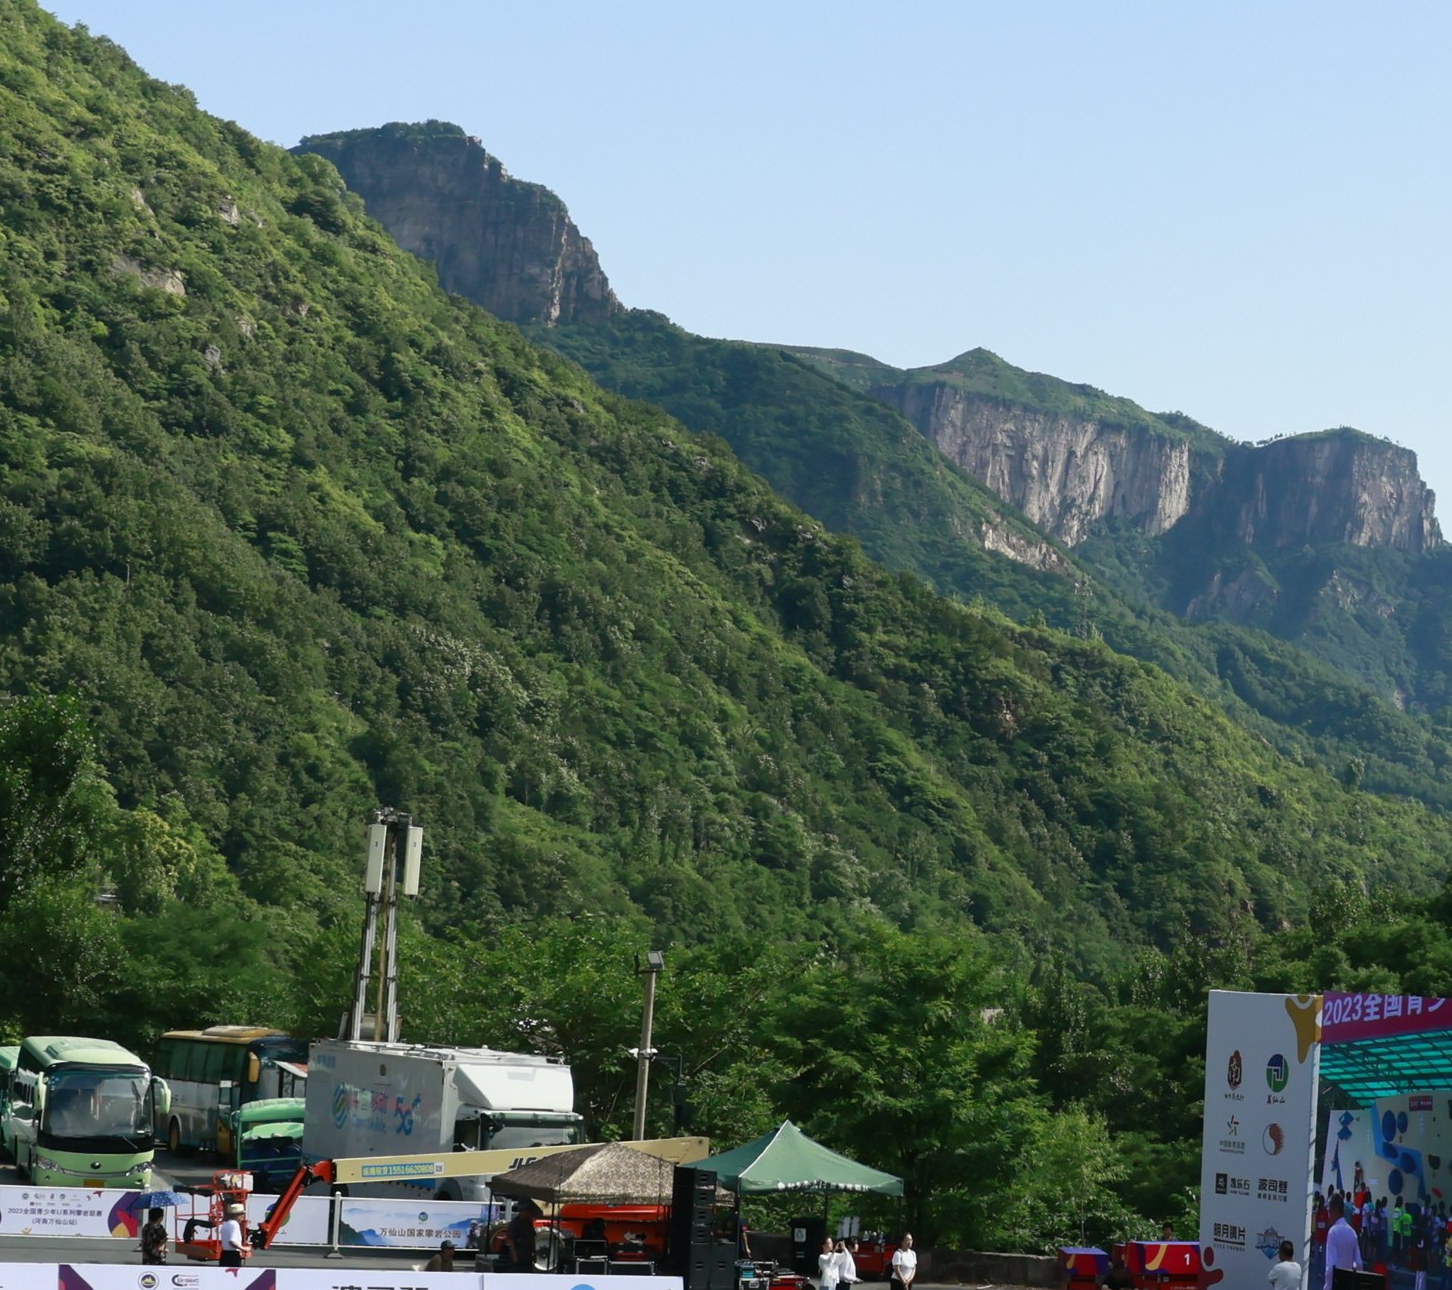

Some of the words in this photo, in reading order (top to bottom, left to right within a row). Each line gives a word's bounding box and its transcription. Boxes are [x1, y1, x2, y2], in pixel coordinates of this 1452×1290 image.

[1258, 1178, 1288, 1194] 波司登
[379, 1227, 462, 1239] 万仙山国家攀岩公园
[1184, 1253, 1191, 1266] 1
